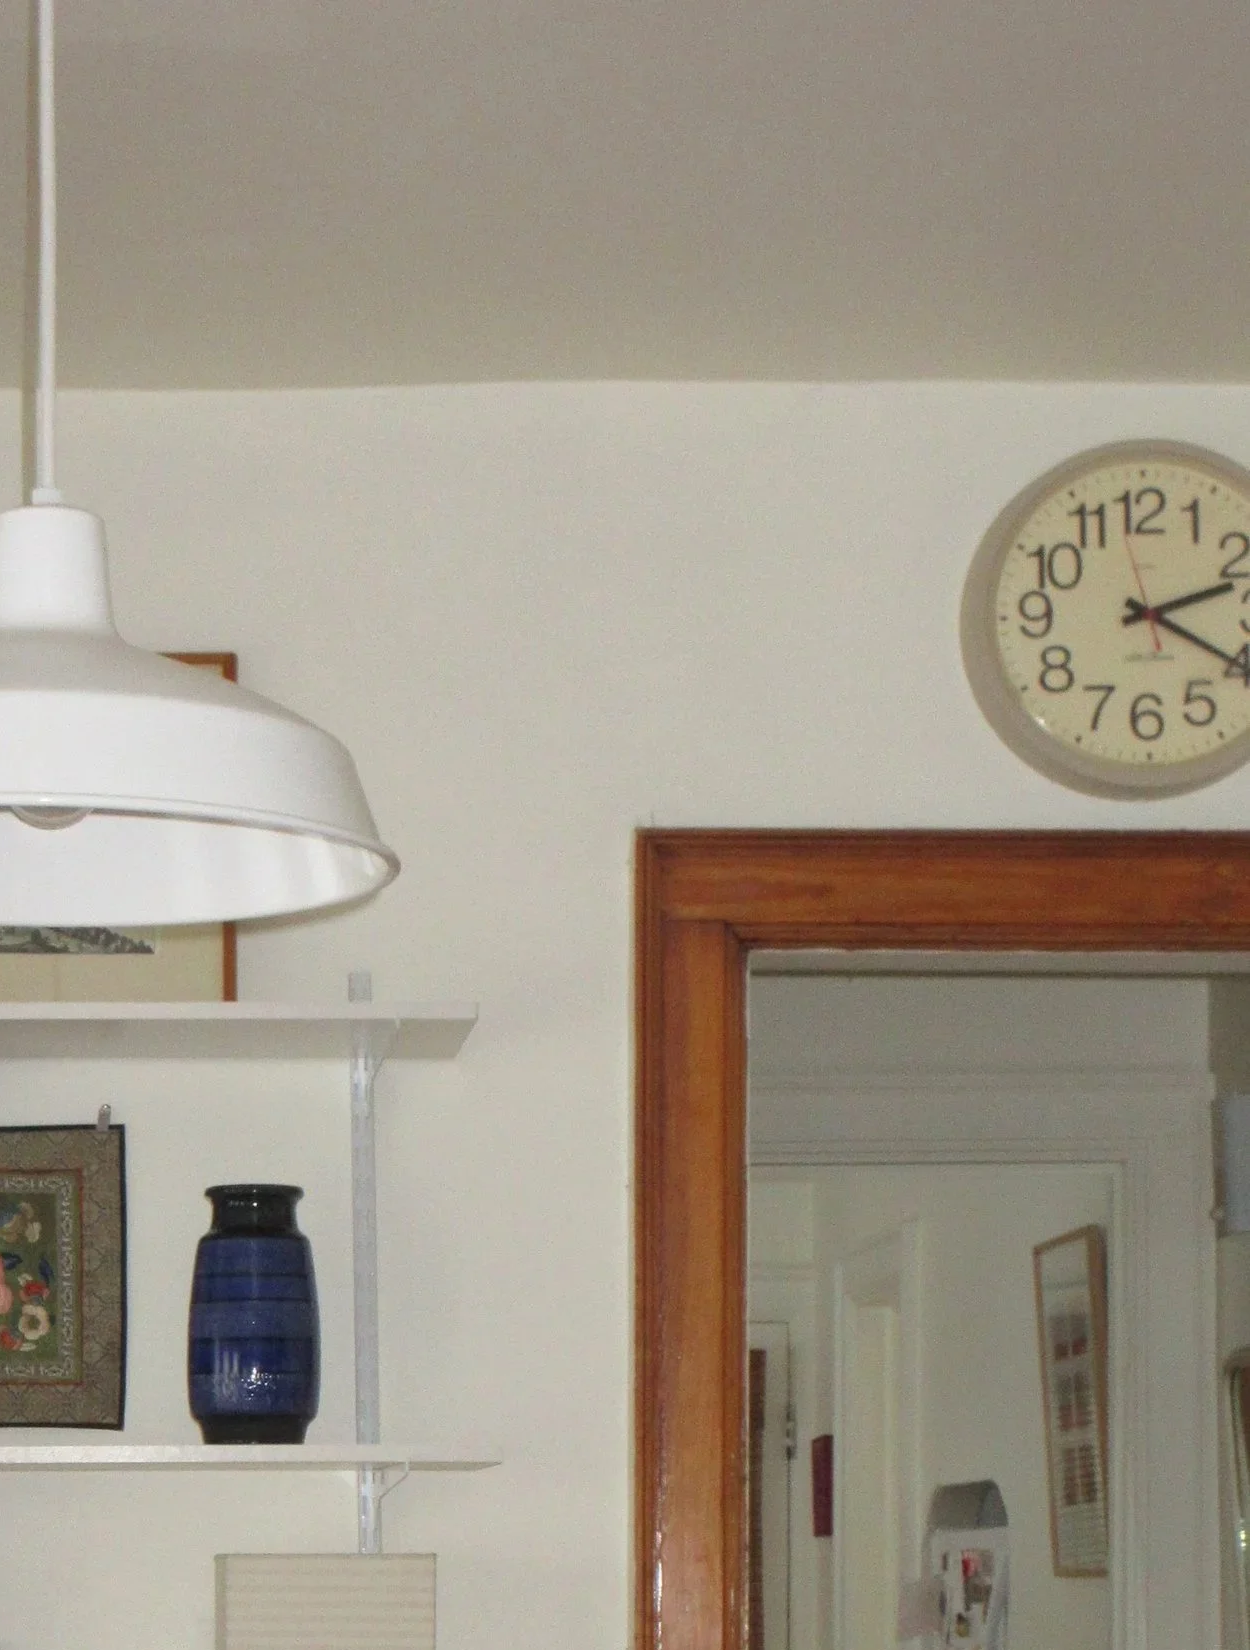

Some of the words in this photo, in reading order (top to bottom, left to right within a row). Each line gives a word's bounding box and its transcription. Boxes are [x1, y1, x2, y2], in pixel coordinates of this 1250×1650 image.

[1067, 503, 1106, 548] 11
[1113, 487, 1166, 535] 12
[1180, 498, 1200, 544] 1
[1026, 541, 1083, 590] 10
[1218, 531, 1250, 579] 2
[1018, 590, 1053, 638] 9
[1039, 645, 1074, 693] 8
[1083, 684, 1115, 732] 7
[1129, 692, 1164, 742] 6
[1182, 679, 1218, 727] 5
